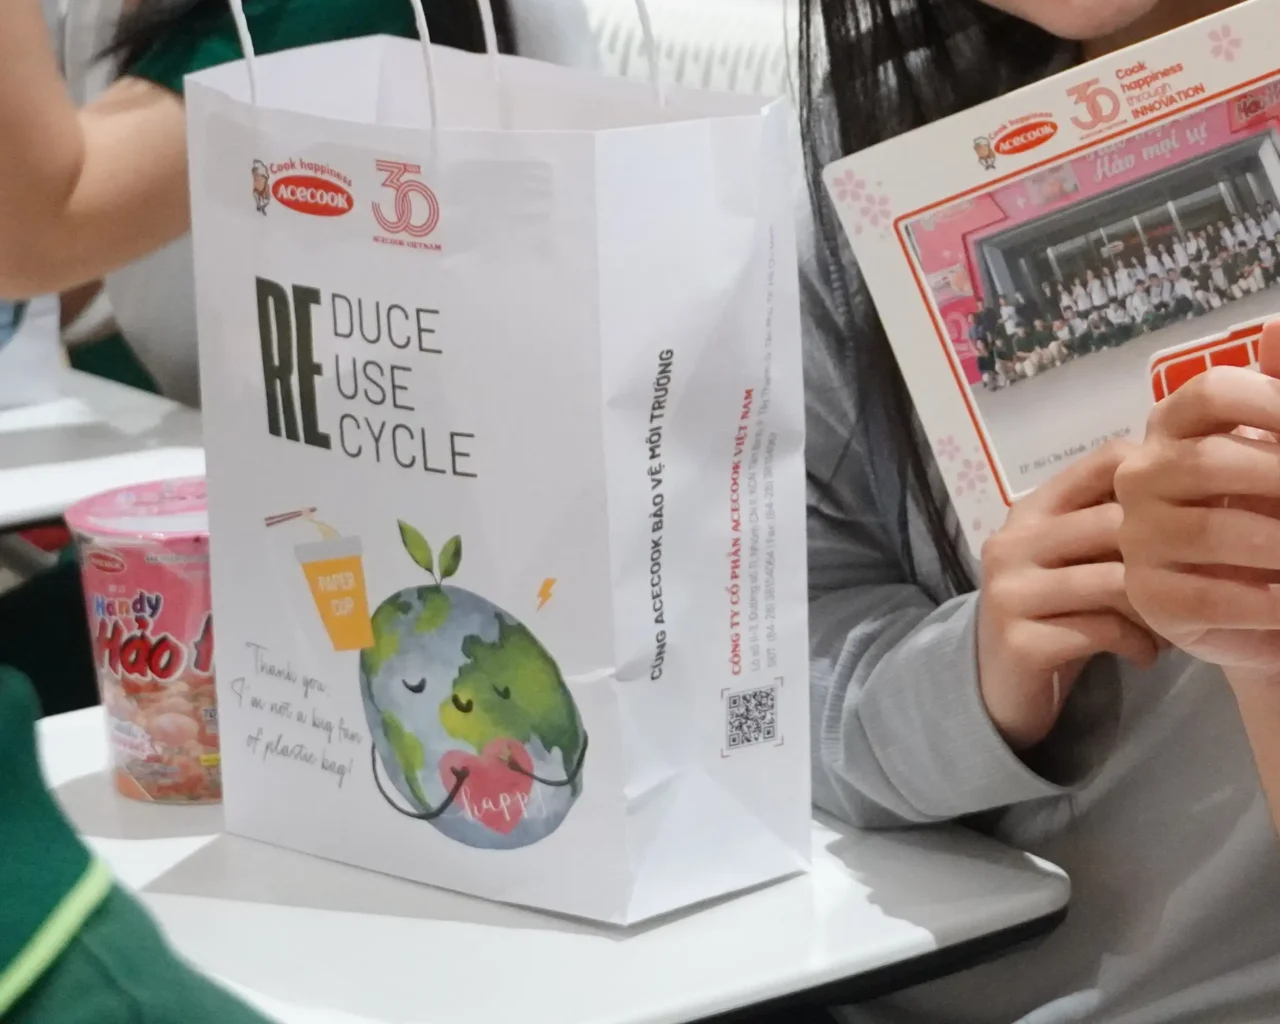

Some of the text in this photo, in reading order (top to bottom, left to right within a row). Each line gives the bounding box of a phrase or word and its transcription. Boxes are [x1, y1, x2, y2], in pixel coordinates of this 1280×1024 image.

[1116, 61, 1148, 80] Cook
[1120, 63, 1184, 94] happiness
[1126, 83, 1172, 106] through
[1132, 83, 1206, 120] INNOVATION
[270, 157, 353, 187] Cook happiness
[372, 159, 440, 237] 30
[331, 292, 443, 354] DUCE
[255, 276, 332, 450] RE
[335, 354, 415, 411] USE
[740, 388, 754, 420] NAM
[339, 413, 478, 478] CYCLE
[733, 426, 748, 457] VIỆT
[645, 349, 674, 681] CÙNG ACECOOK BẢO VỆ MÔI TRƯỜNG
[730, 460, 742, 532] ACECOOK
[95, 589, 162, 619] Handy
[730, 609, 741, 629] TY
[245, 641, 297, 684] Thank
[729, 632, 742, 675] CÔNG
[246, 727, 263, 755] of
[262, 733, 317, 765] plastic
